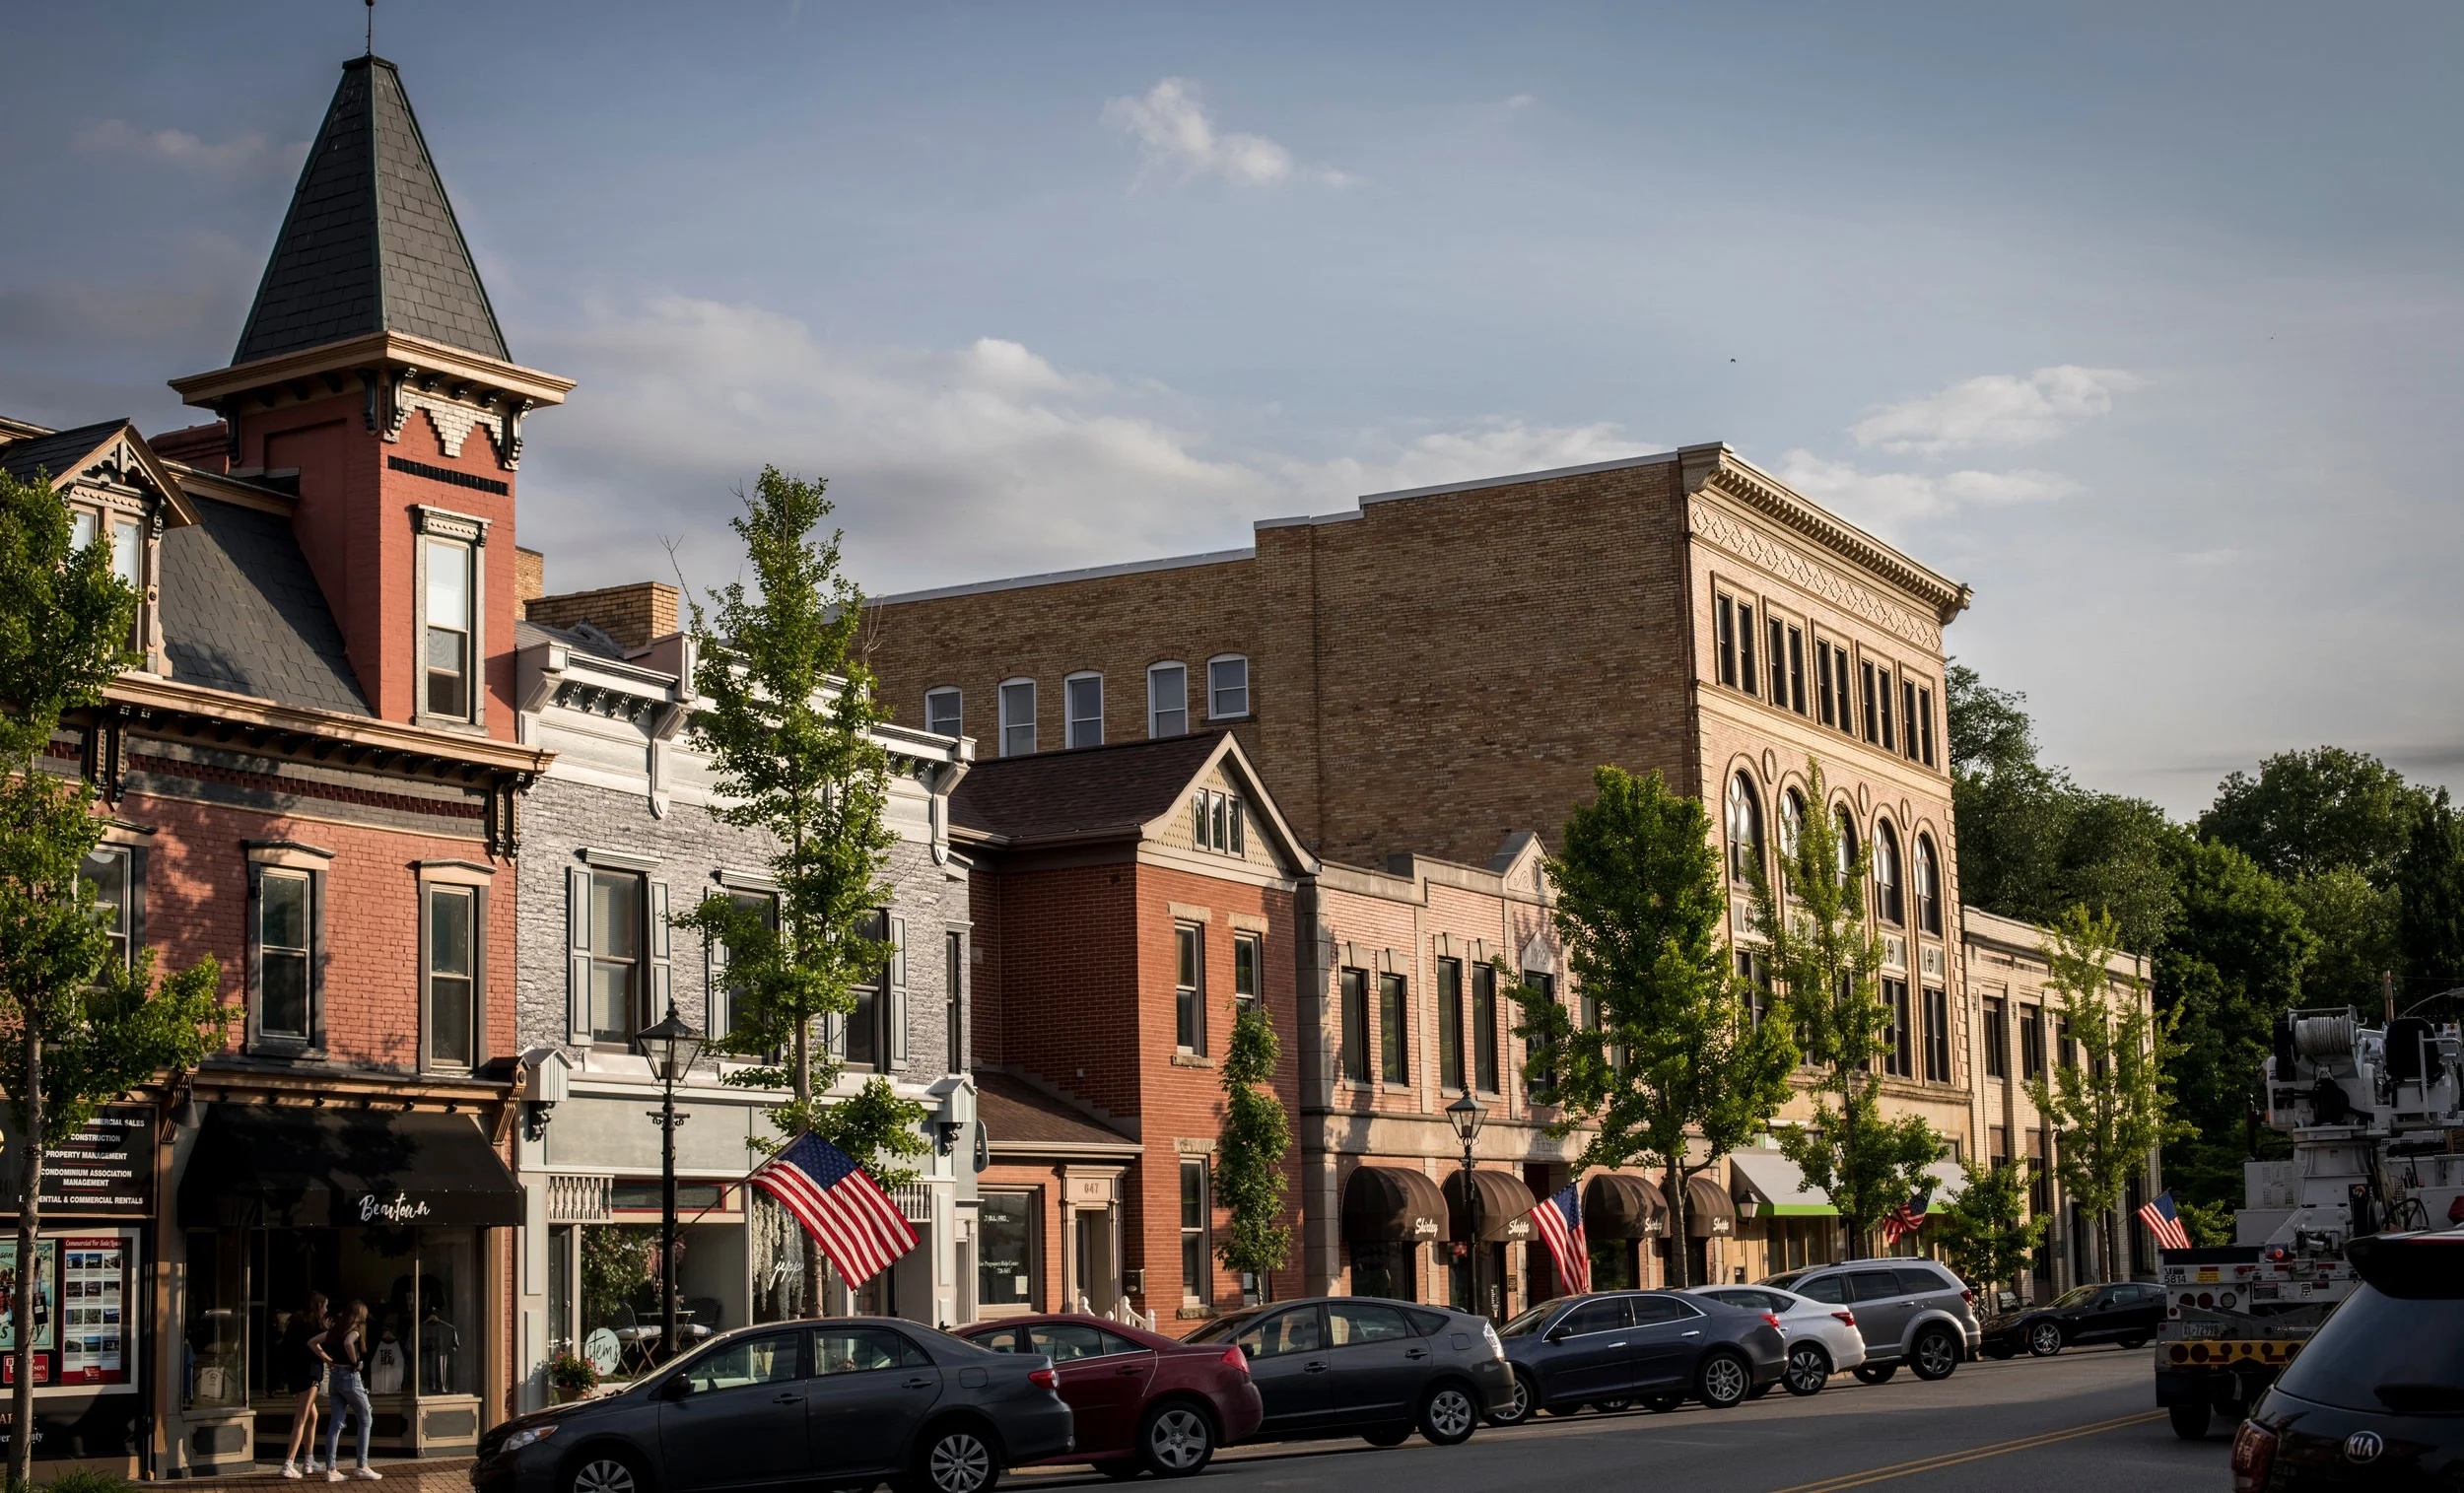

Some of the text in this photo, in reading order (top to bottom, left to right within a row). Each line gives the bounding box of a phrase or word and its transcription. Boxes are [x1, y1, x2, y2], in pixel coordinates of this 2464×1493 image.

[70, 1133, 120, 1143] CONSTRUCTION
[45, 1150, 127, 1161] PROPERTY MANAGEMENT
[40, 1168, 132, 1178] CONDOMINIUM ASSOCIATION
[62, 1179, 109, 1188] MANAGEMENT
[1084, 1182, 1099, 1193] 647
[62, 1195, 69, 1204] &
[70, 1195, 113, 1204] COMMERCIAL
[1415, 1217, 1439, 1238] Shirley
[1508, 1218, 1530, 1237] Shoppe
[1645, 1217, 1662, 1233] Shirley
[1713, 1217, 1730, 1233] Shoppe
[2164, 1274, 2186, 1283] 5814
[2347, 1436, 2374, 1458] KIA
